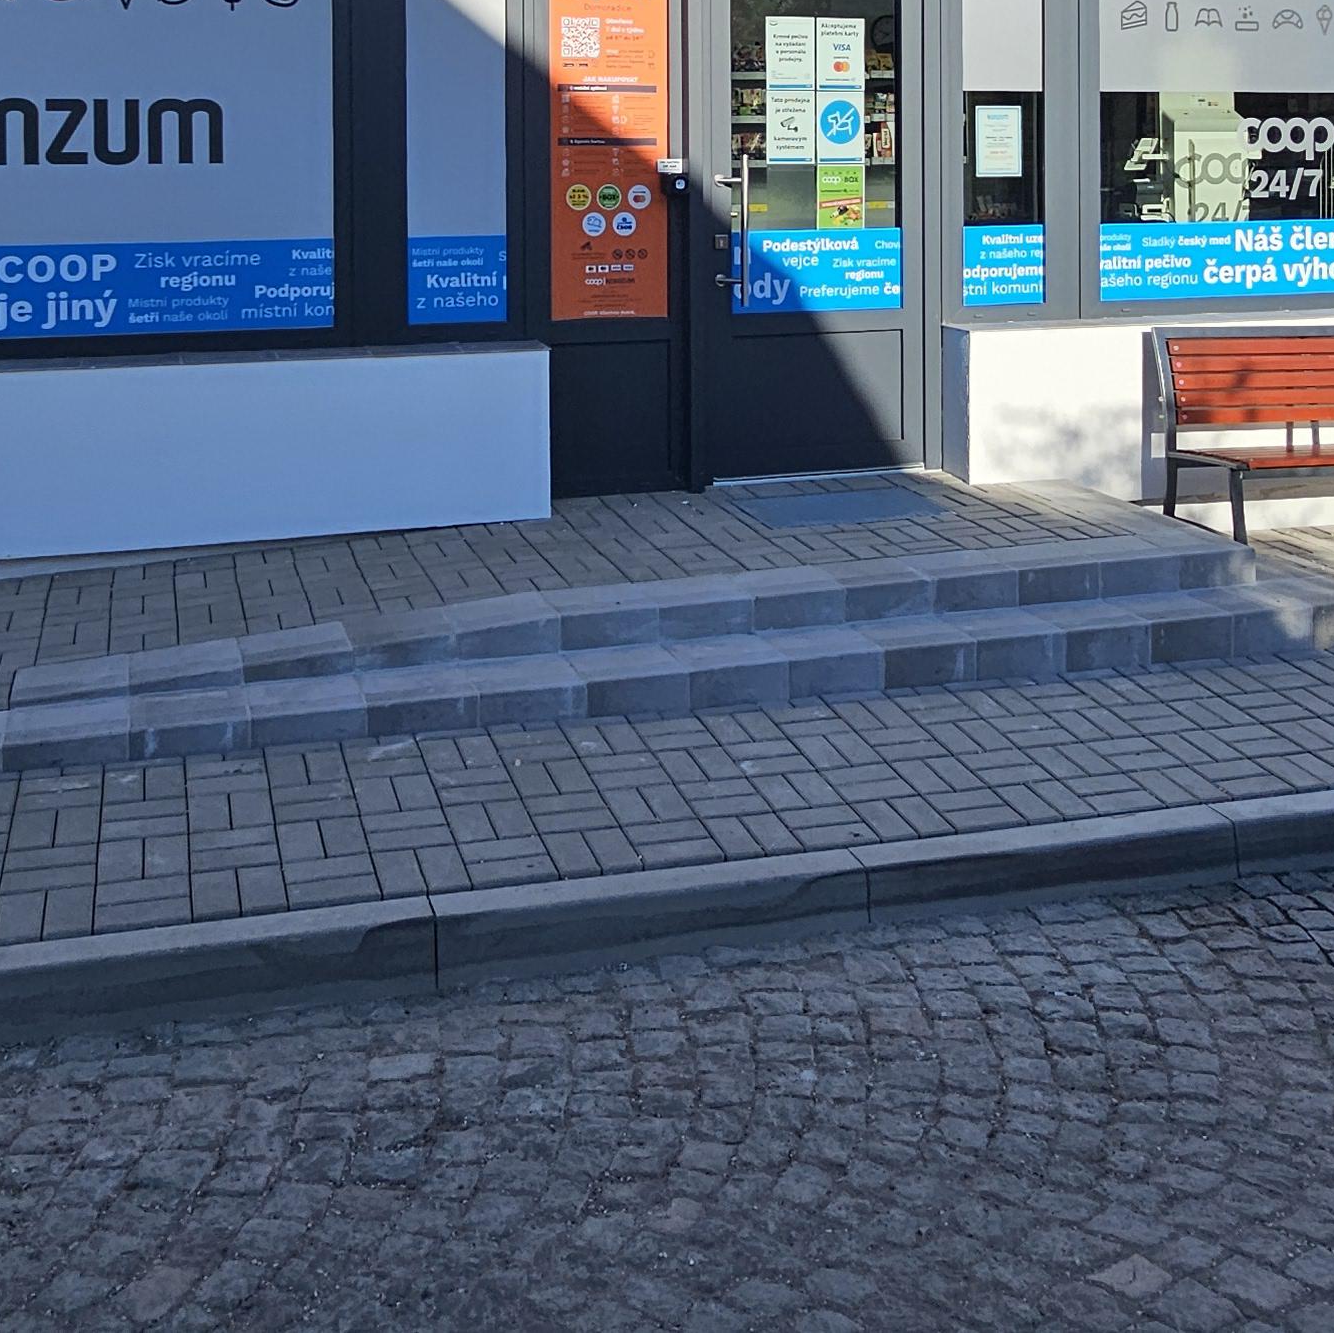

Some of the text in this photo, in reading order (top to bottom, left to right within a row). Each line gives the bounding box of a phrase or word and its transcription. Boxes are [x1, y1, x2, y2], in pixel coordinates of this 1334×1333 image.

[833, 43, 852, 52] VISA
[1250, 167, 1323, 201] 24/7
[762, 237, 859, 254] Podestýlková
[982, 233, 1024, 245] Kvalitní
[1141, 235, 1232, 249] Sladký český med
[1234, 225, 1284, 253] Náš
[134, 250, 262, 268] Zisk vracíme
[411, 246, 485, 257] Místní produkty
[979, 250, 987, 259] z
[989, 247, 1027, 259] našeho
[288, 264, 333, 276] z naše
[436, 258, 458, 267] naše
[460, 257, 484, 266] okolí
[782, 255, 820, 270] vejce
[832, 257, 897, 268] Zisk vracíme
[1144, 254, 1192, 272] pečivo
[160, 271, 236, 292] regionu
[426, 270, 498, 289] Kvalitní
[845, 269, 884, 282] regionu
[1147, 272, 1199, 289] regionu
[1203, 257, 1278, 290] čerpá
[254, 282, 335, 302] Podporuj
[799, 284, 880, 299] Preferujeme
[127, 296, 230, 309] Místní produkty
[416, 291, 499, 309] z našeho
[41, 289, 118, 330] jiný
[128, 309, 228, 324] šetří naše okolí
[241, 303, 298, 320] místní
